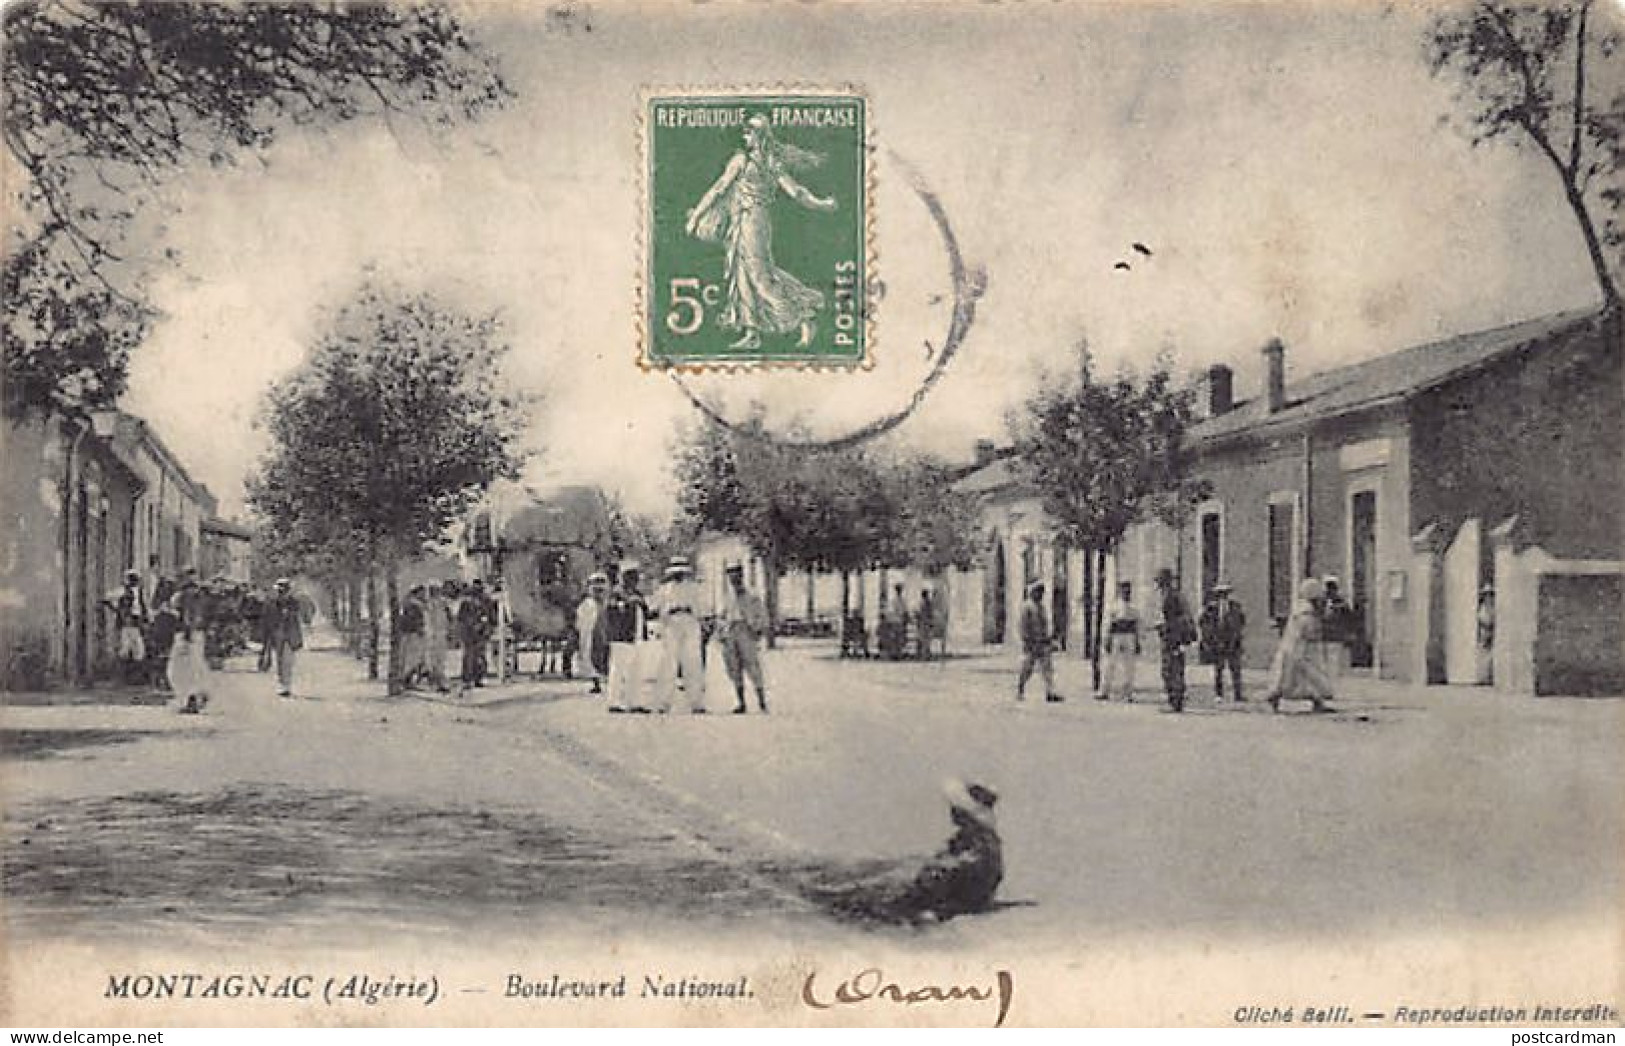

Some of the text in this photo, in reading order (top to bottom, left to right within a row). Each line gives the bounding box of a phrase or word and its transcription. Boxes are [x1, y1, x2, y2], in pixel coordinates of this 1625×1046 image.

[835, 261, 855, 345] POSTES
[104, 974, 755, 1005] MONTAGNAC (Algérie) Boulevard National.
[1233, 1005, 1294, 1023] Cliché
[1394, 1006, 1527, 1024] Reproduction
[1533, 1004, 1619, 1022] Interdite
